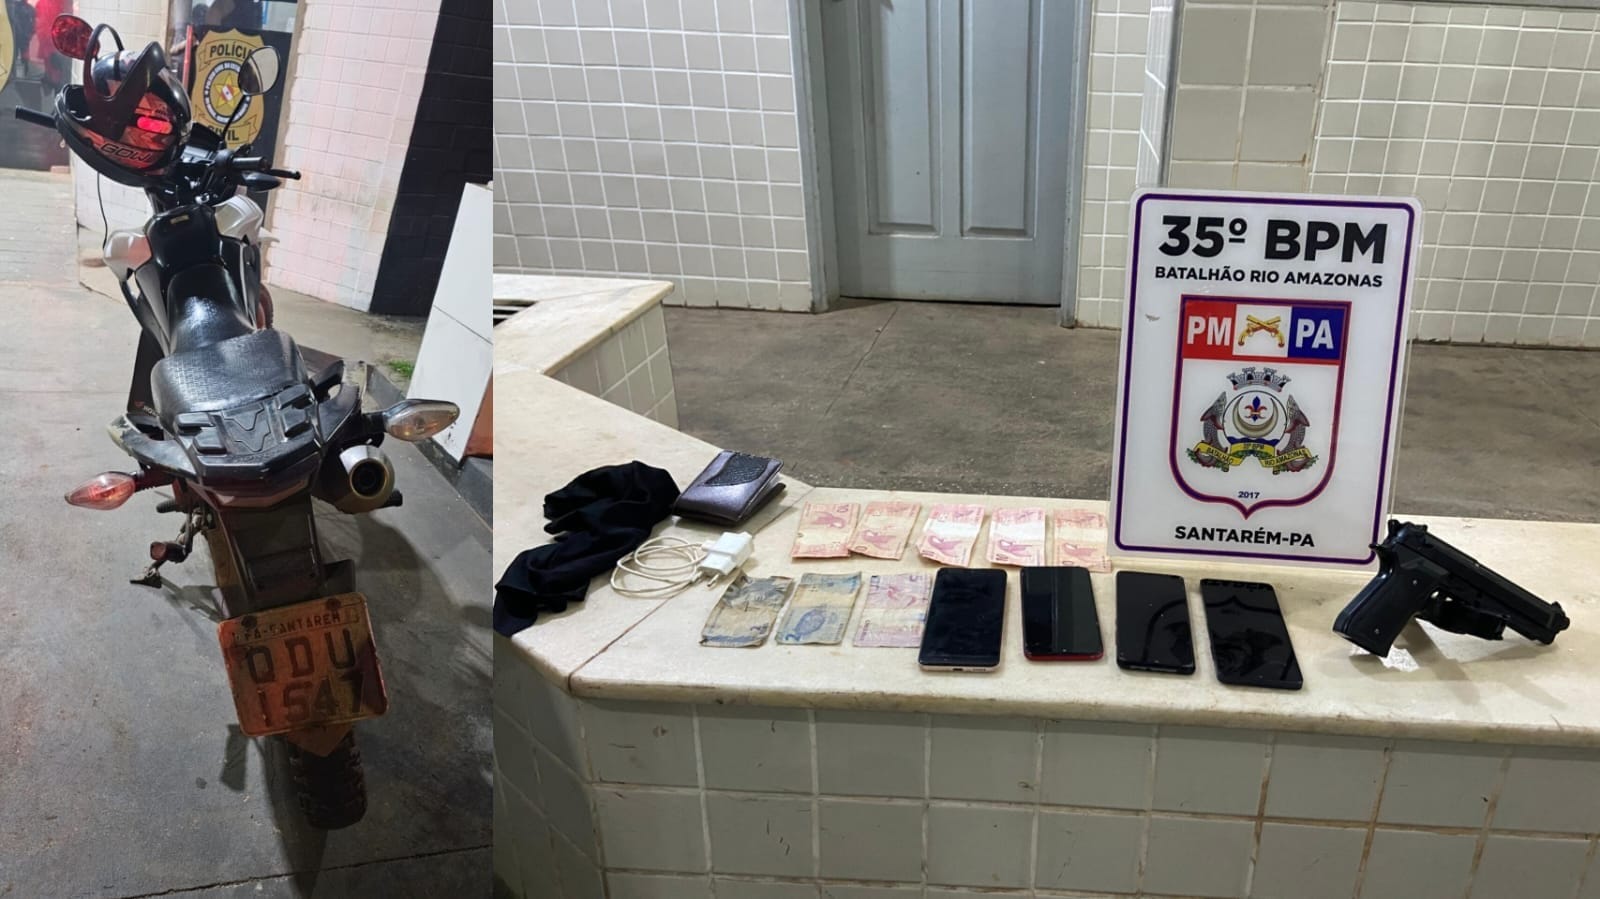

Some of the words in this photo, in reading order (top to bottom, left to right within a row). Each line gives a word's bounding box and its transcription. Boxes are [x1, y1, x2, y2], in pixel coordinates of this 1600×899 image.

[1158, 215, 1248, 258] 35º
[1264, 219, 1388, 264] BPM
[1155, 266, 1245, 282] BATALHÃO
[1250, 270, 1279, 284] RIO
[1284, 271, 1383, 288] AMAZONAS
[1186, 315, 1232, 346] PM
[1295, 318, 1334, 349] PA
[1238, 491, 1260, 499] 2017
[1175, 526, 1315, 547] SANTARÉM-PA
